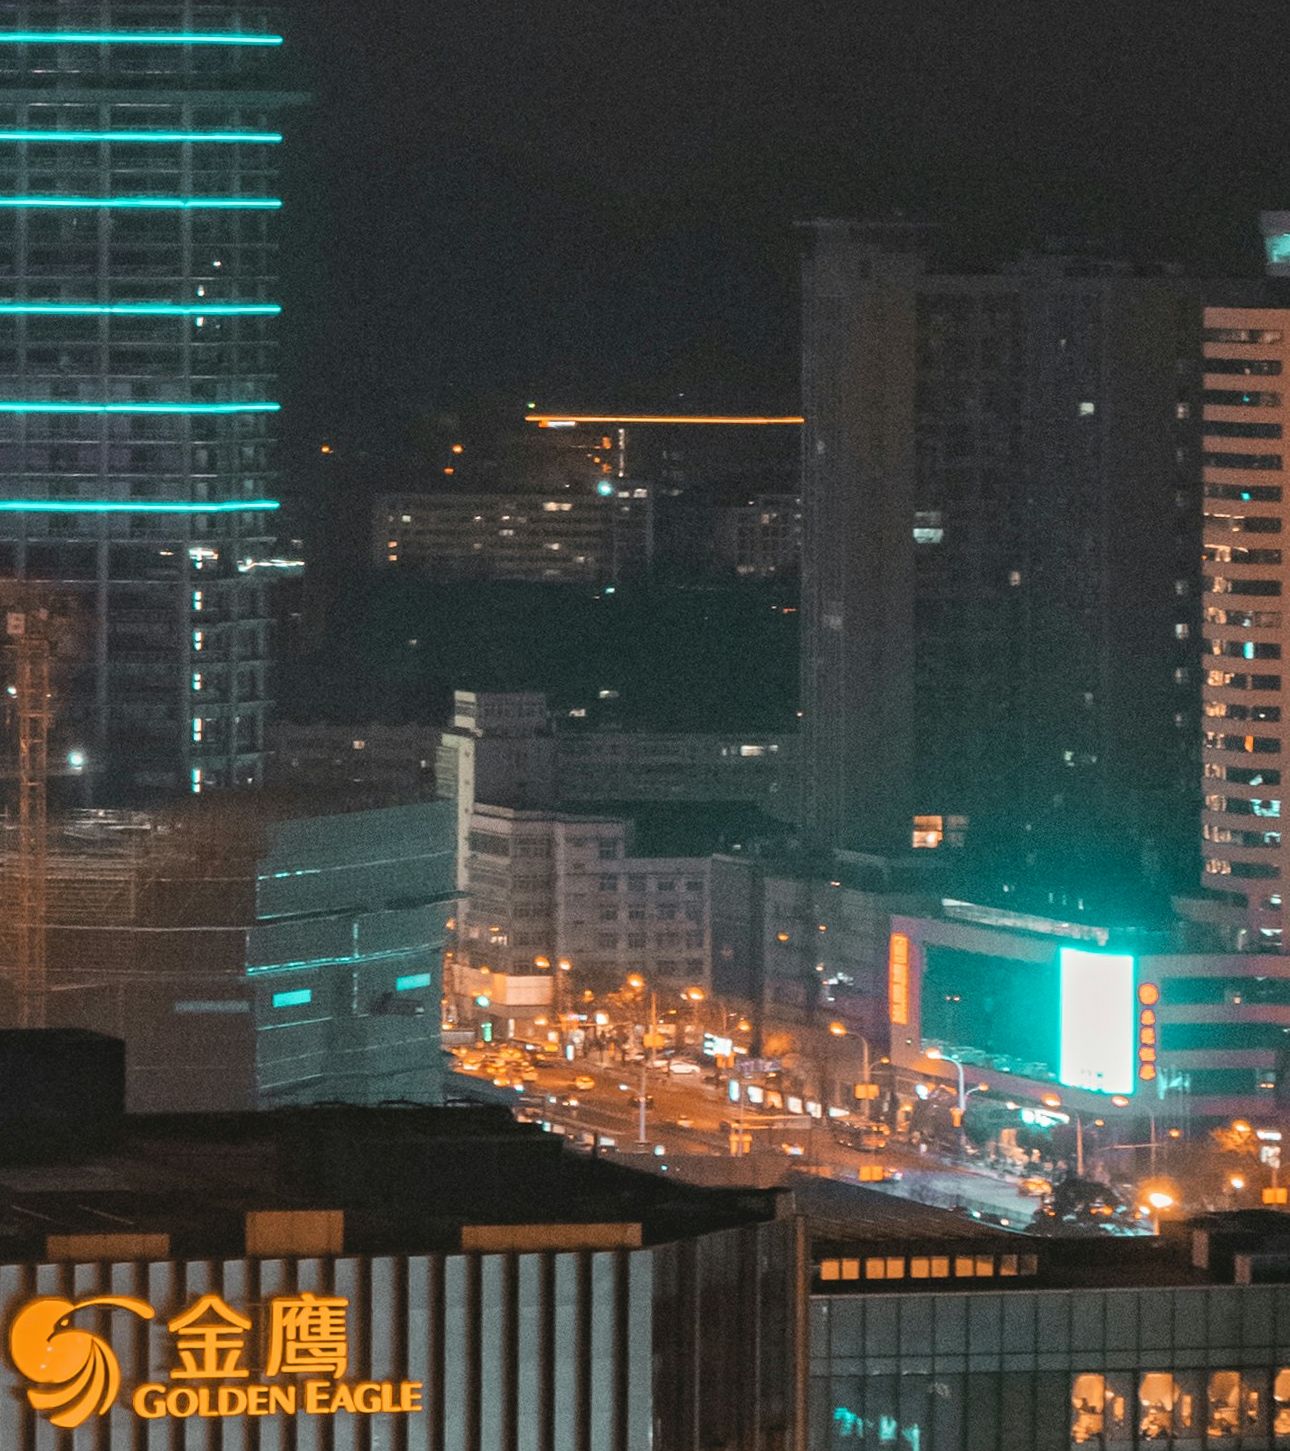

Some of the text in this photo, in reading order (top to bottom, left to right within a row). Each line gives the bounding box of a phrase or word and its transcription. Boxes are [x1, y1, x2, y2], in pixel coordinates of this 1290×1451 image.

[168, 1293, 349, 1379] 金鹰
[133, 1380, 424, 1419] GOLDEN EAGLE
